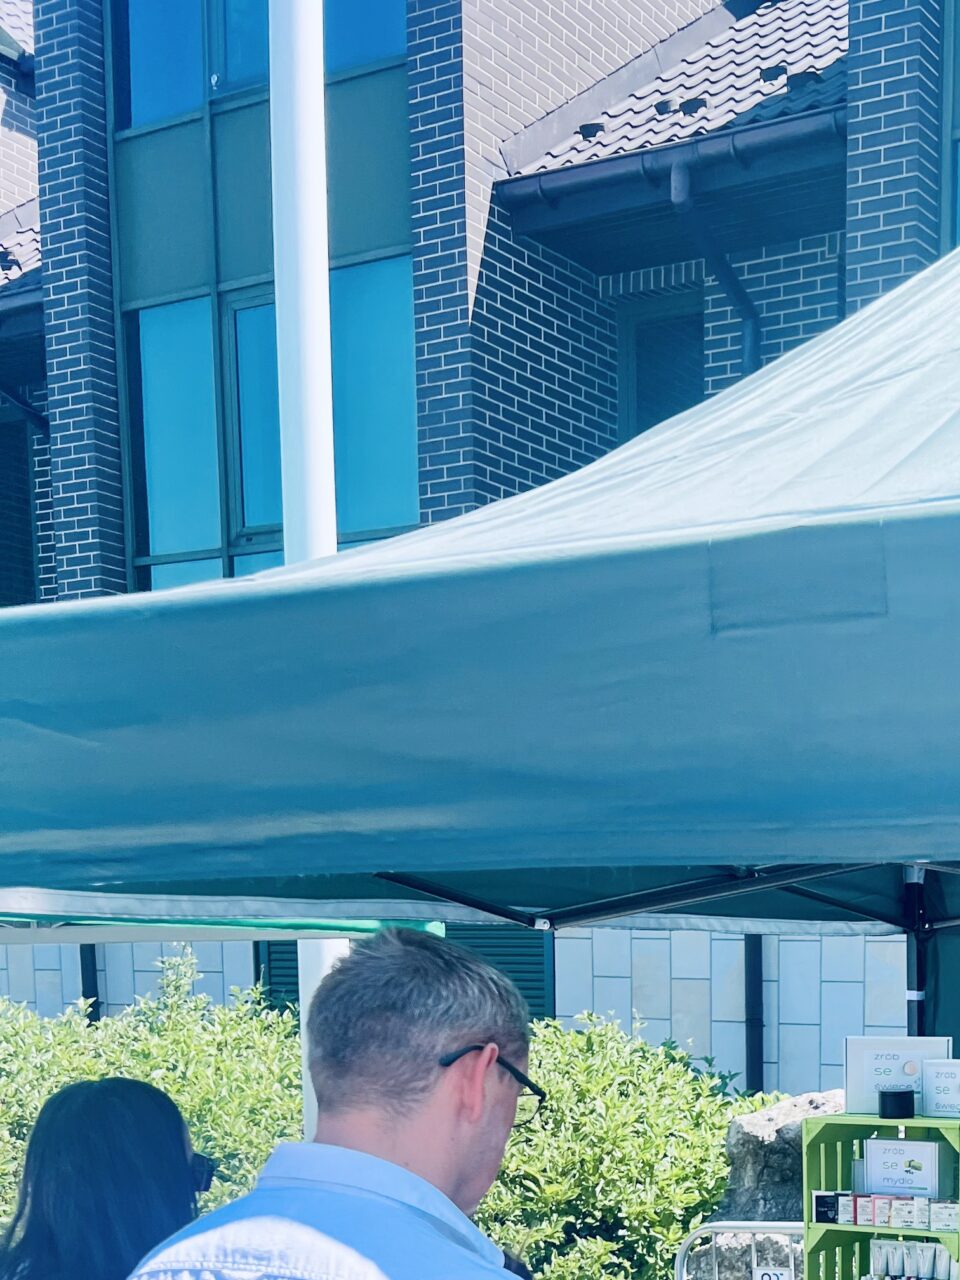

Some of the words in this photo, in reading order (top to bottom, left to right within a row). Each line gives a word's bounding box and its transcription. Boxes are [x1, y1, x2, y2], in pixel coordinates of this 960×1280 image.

[874, 1067, 892, 1076] se
[935, 1086, 951, 1095] se
[882, 1161, 898, 1170] se
